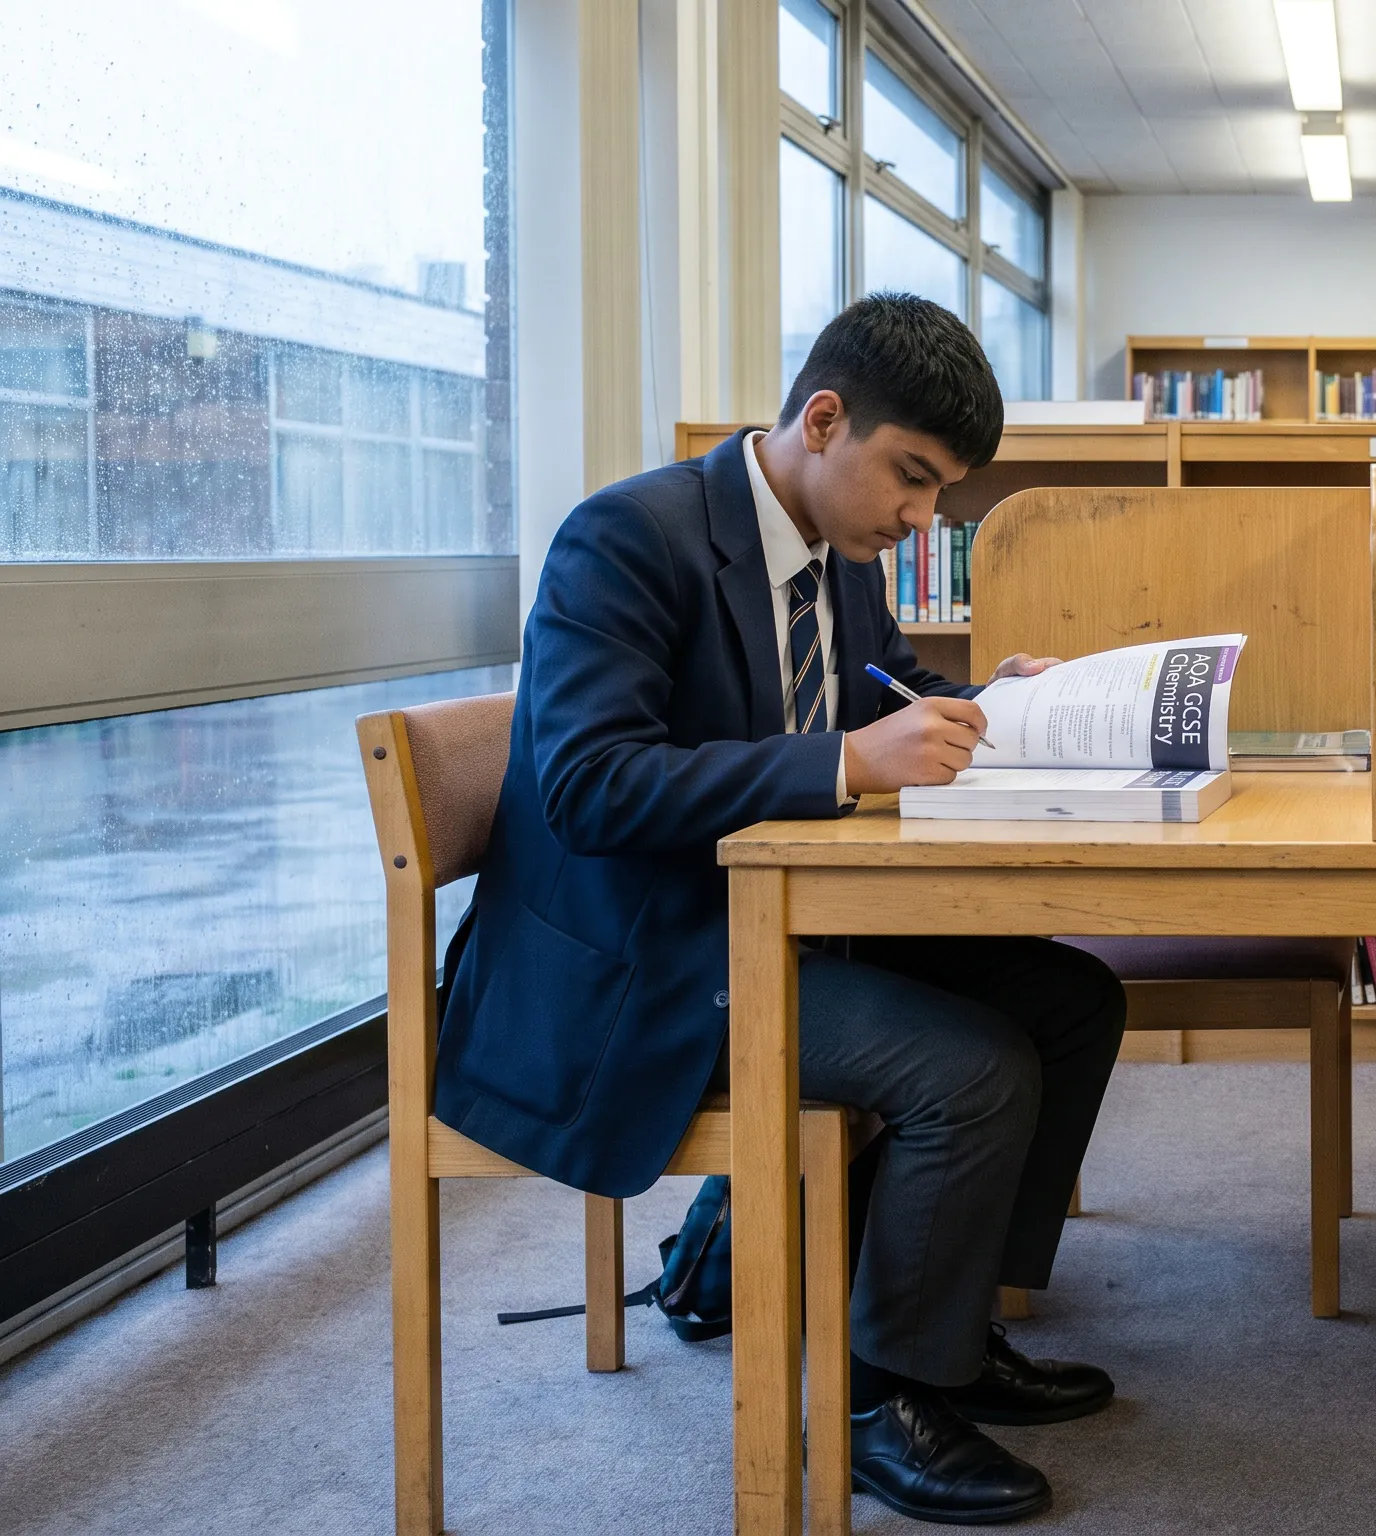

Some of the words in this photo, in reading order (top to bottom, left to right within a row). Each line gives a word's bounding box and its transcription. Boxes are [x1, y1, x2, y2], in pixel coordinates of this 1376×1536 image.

[1185, 653, 1212, 688] AQA
[1154, 653, 1189, 745] Chemistry
[1181, 692, 1203, 744] GCSE
